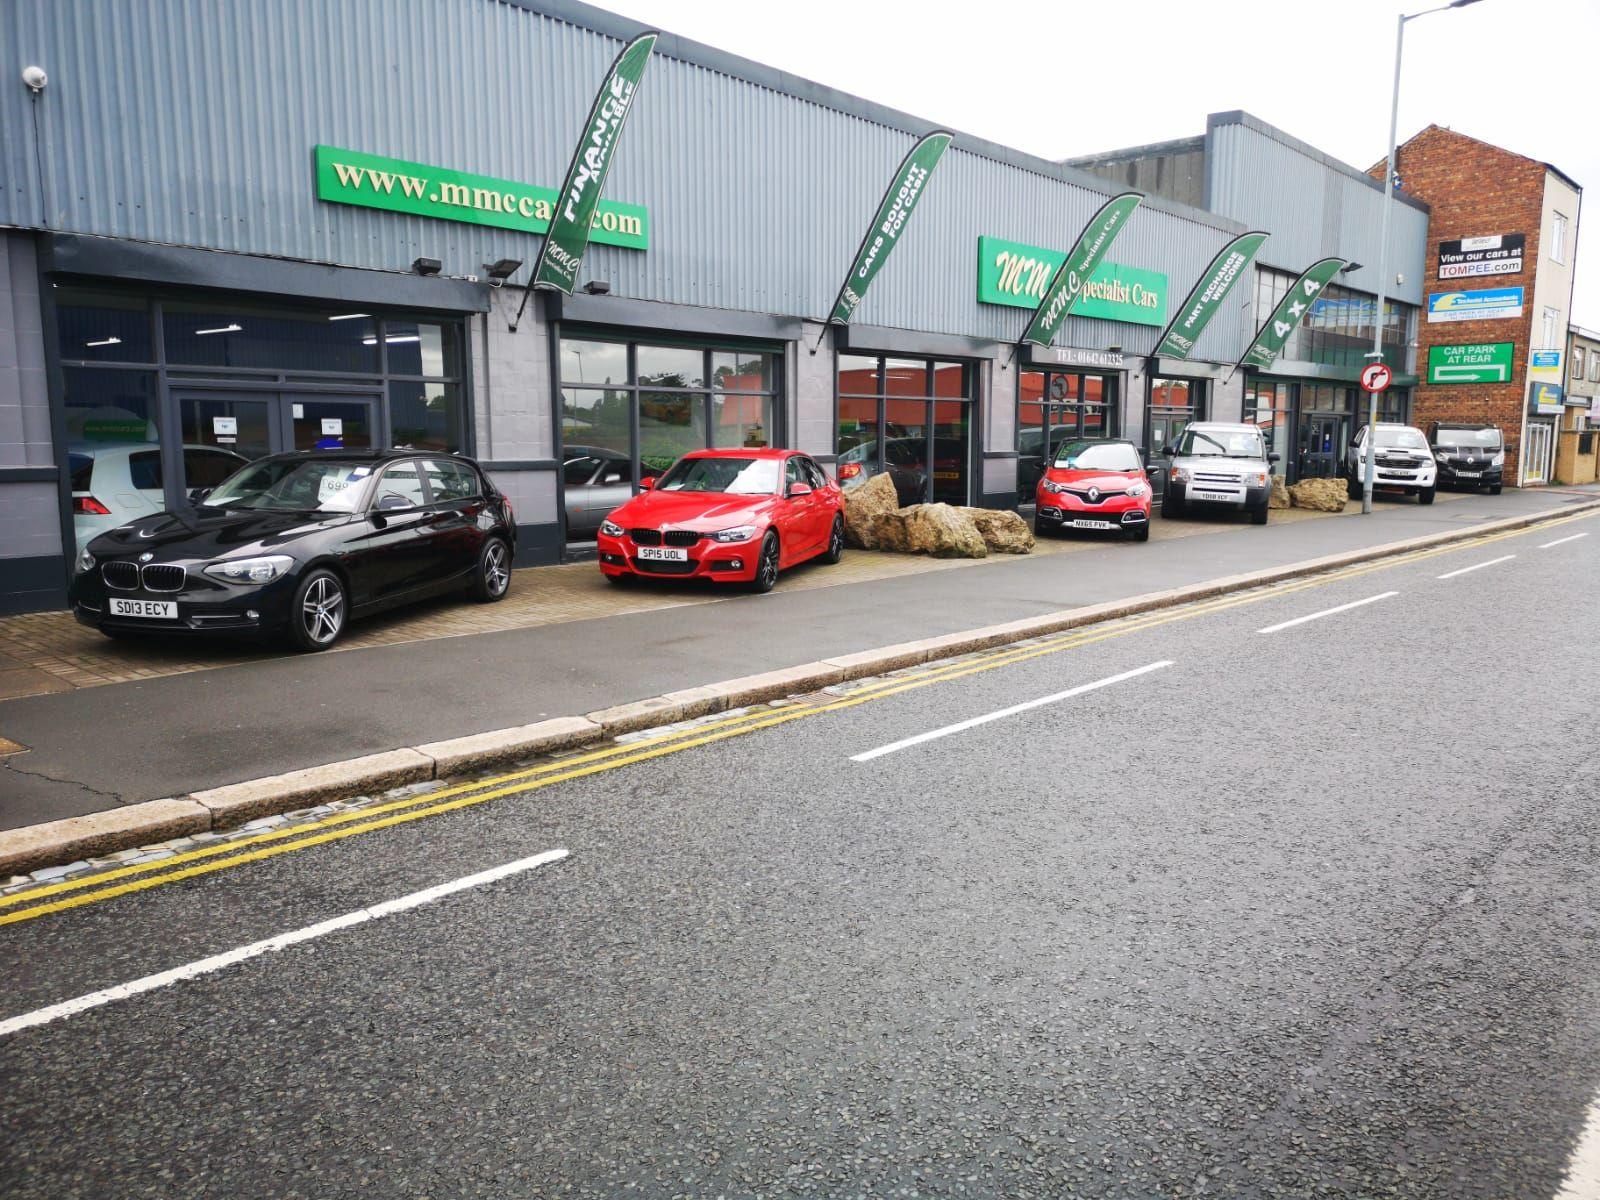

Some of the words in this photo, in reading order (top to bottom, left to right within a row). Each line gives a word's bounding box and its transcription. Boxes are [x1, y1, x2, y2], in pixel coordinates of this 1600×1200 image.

[888, 209, 907, 239] FOR
[904, 167, 928, 208] CASH
[859, 235, 884, 278] CARS
[881, 163, 920, 234] BOUGHT
[1103, 210, 1121, 231] Cars
[1441, 254, 1464, 263] View
[1466, 252, 1484, 260] our
[1486, 249, 1508, 259] cars
[1511, 247, 1522, 257] at
[1211, 254, 1246, 301] WELCOME
[1441, 262, 1520, 276] TOMPEE.com
[995, 250, 1060, 300] MM
[1082, 277, 1130, 304] pecialist
[1132, 283, 1158, 308] Cars
[1184, 302, 1204, 328] PART
[1201, 251, 1241, 303] EXCHANGE
[1274, 320, 1291, 338] 4
[1304, 279, 1321, 297] 4
[1056, 349, 1076, 362] TEL:
[1443, 346, 1465, 356] CAR
[1468, 345, 1496, 354] PARK
[1447, 355, 1462, 364] AT
[1463, 354, 1491, 363] REAR
[643, 549, 662, 559] SP15
[117, 601, 142, 615] SD13
[145, 603, 169, 616] ECY
